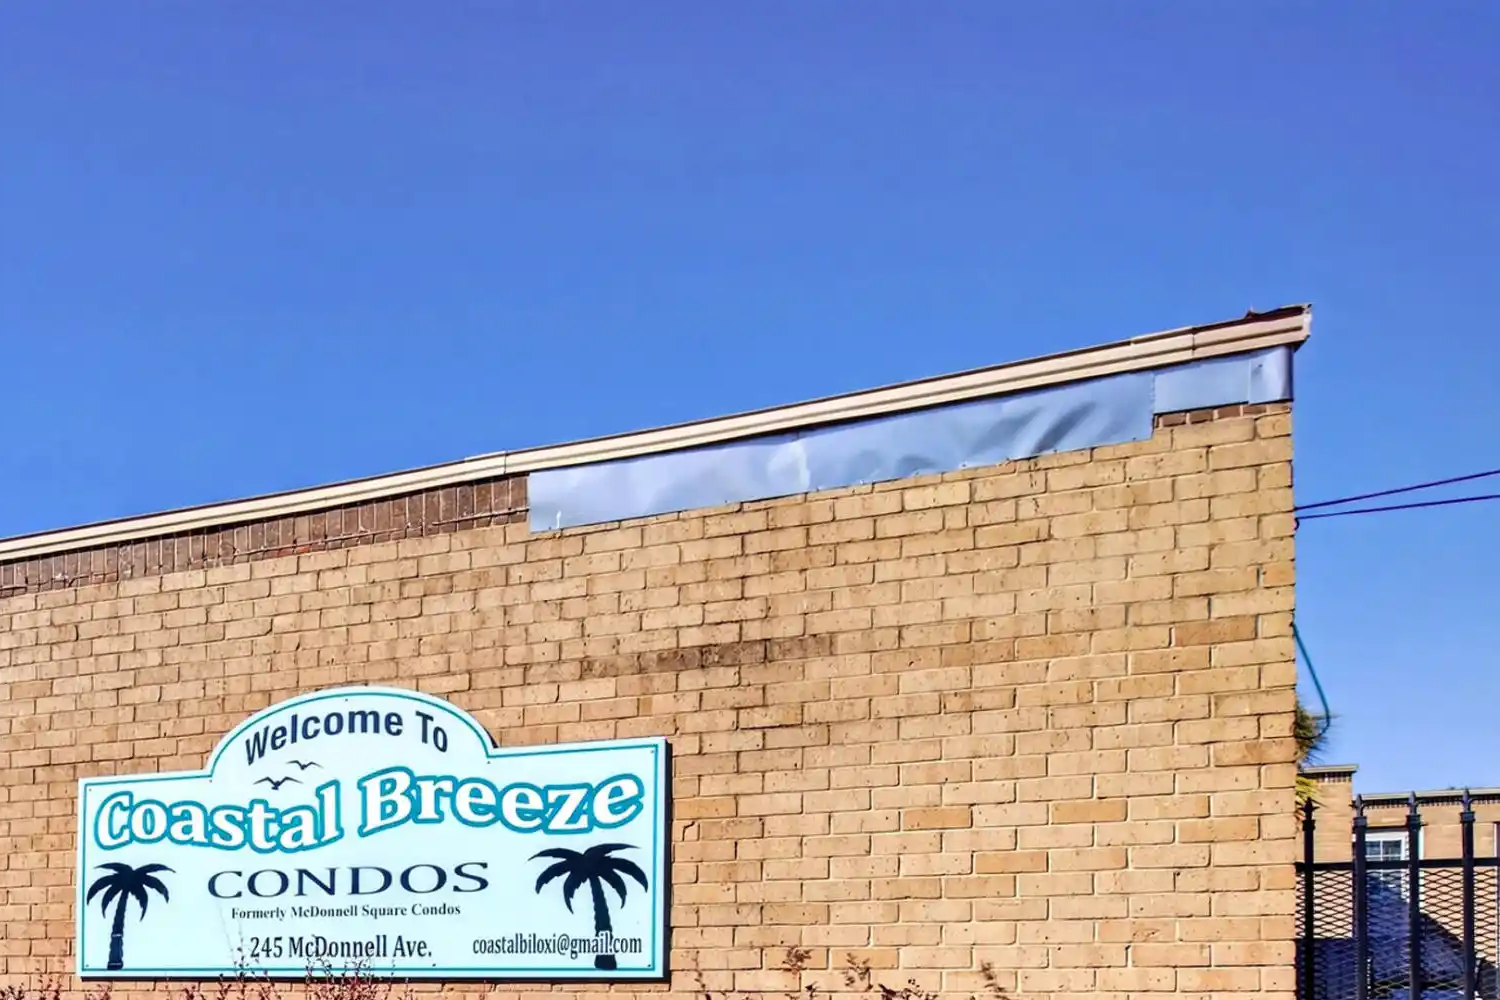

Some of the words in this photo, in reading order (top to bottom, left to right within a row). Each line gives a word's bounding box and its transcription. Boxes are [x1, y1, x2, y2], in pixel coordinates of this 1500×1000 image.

[244, 709, 404, 766] Welcome
[415, 710, 449, 753] To
[94, 779, 343, 854] Coastal
[357, 766, 646, 836] Breeze
[207, 861, 490, 899] CONDOS
[231, 906, 287, 921] Formerly
[291, 904, 358, 918] McDonnell
[361, 904, 408, 919] Square
[411, 902, 462, 916] Condos
[249, 935, 284, 959] 245
[288, 934, 388, 959] McDonnell
[392, 934, 433, 958] Ave.
[472, 932, 643, 961] coastalbiloxi@gmail.com
